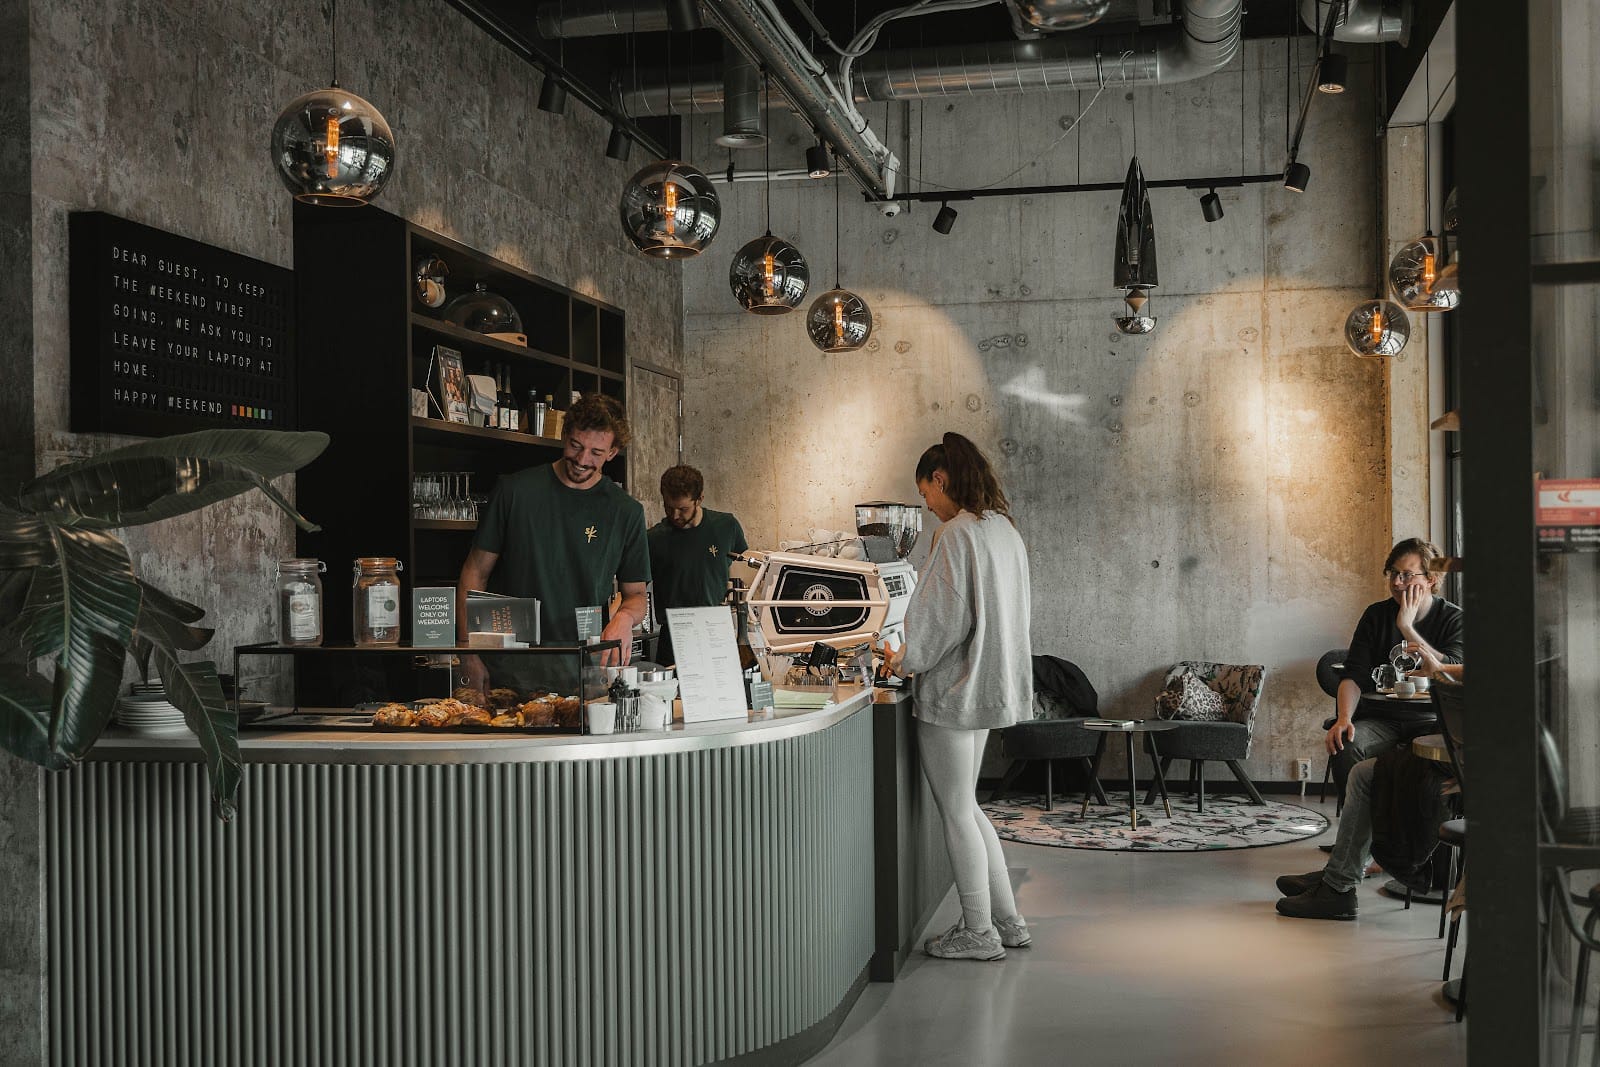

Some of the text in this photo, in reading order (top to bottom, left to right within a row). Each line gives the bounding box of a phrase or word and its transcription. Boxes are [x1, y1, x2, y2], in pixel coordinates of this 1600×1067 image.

[113, 246, 147, 266] DEAR
[215, 275, 229, 288] TO
[238, 282, 265, 298] KEEP
[113, 275, 244, 318] THE WEEKEND VIBE
[175, 317, 190, 331] WE
[200, 322, 221, 337] ASK
[231, 329, 251, 344] YOU
[260, 336, 272, 348] TO
[113, 331, 272, 373] LEAVE YOUR LAPTOP AT
[113, 388, 223, 414] HAPPY WEEKEND
[418, 603, 450, 611] WELCOME
